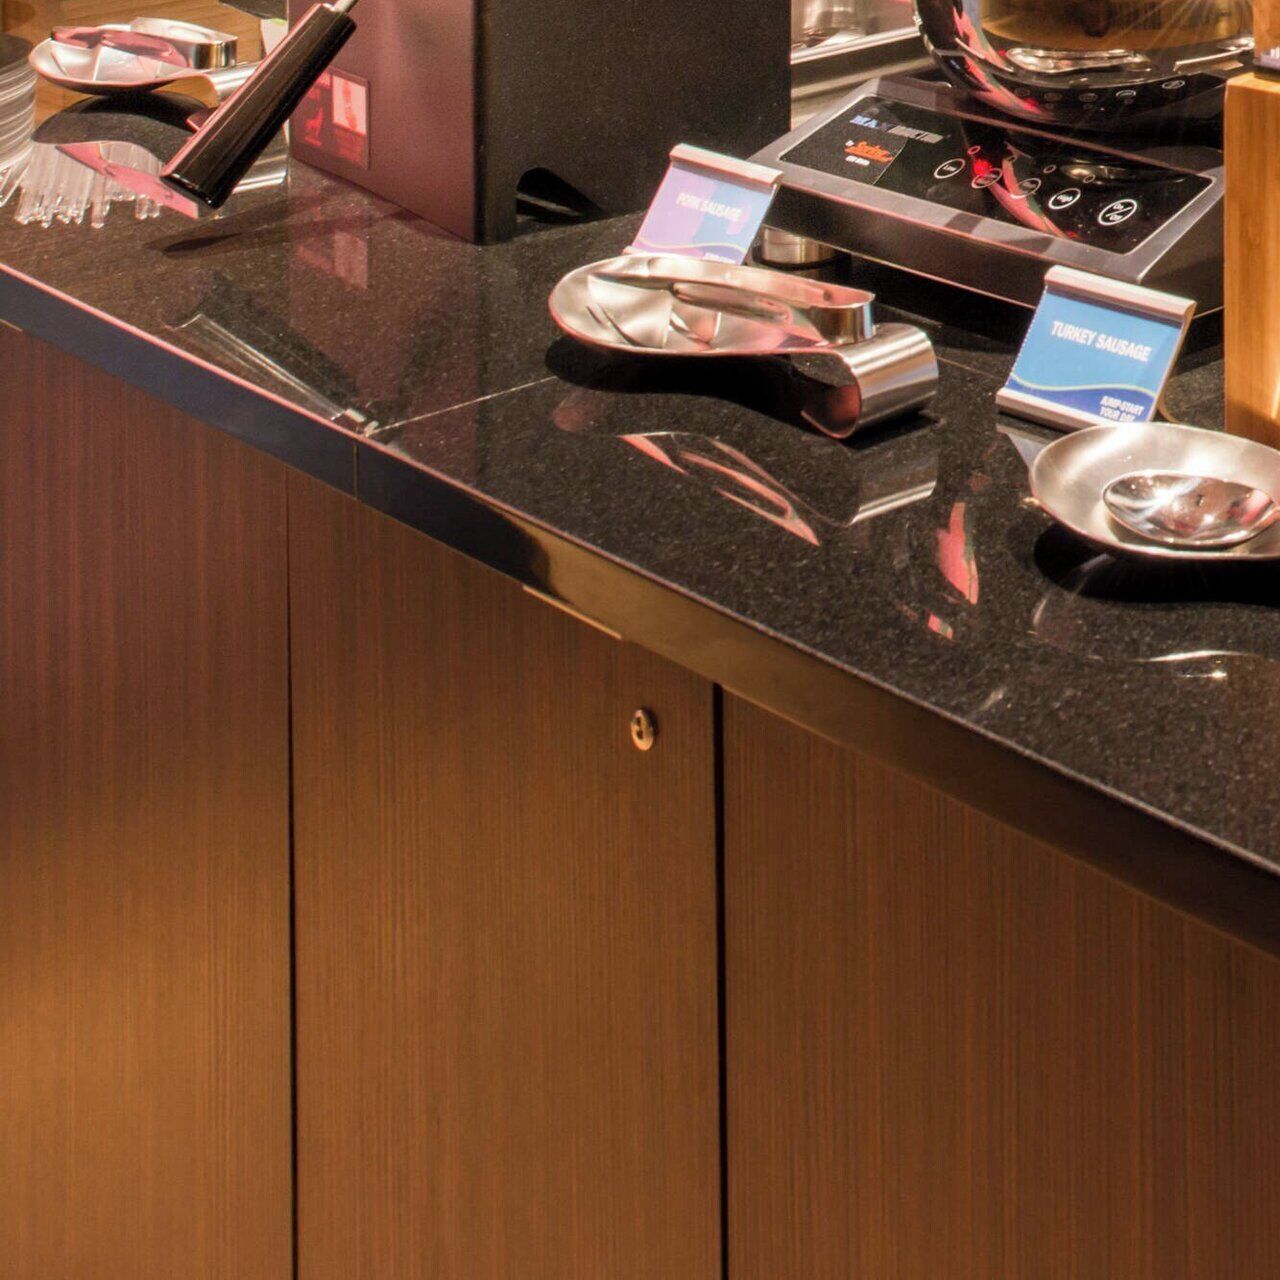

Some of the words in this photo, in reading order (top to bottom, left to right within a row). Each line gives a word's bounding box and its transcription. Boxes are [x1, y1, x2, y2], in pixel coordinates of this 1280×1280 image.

[676, 192, 701, 210] PORK
[700, 199, 743, 222] SAUSAGE
[1051, 320, 1098, 347] TURKEY
[1095, 332, 1153, 363] SAUSAGE
